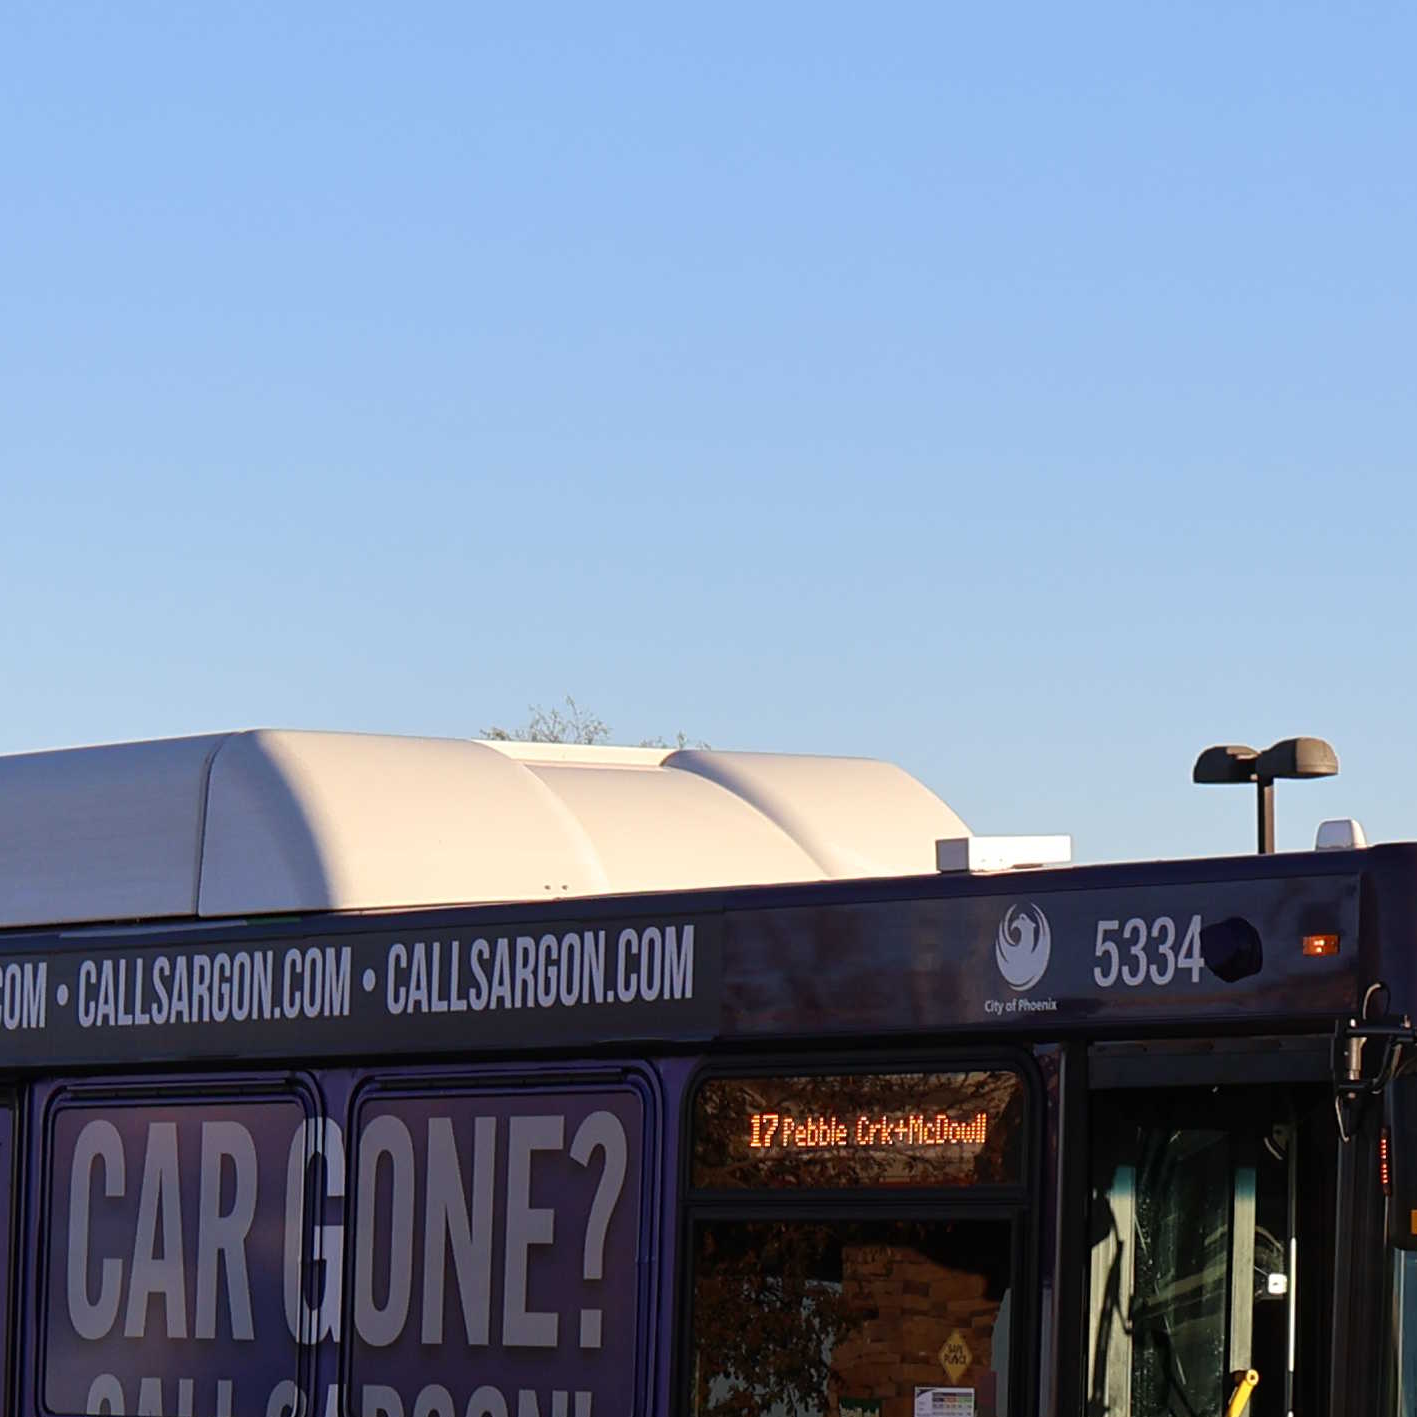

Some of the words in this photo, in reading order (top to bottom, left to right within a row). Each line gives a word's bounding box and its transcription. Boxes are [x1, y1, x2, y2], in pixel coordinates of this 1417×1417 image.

[77, 946, 352, 1028] CALLSARGON.COM
[386, 924, 695, 1015] CALLSARGON.COM
[1093, 913, 1205, 987] 5334
[984, 999, 1004, 1015] City
[1006, 998, 1017, 1011] of
[1019, 998, 1057, 1011] Phoenix
[750, 1113, 779, 1147] 17
[782, 1115, 848, 1147] Pebble
[67, 1118, 258, 1341] CAR
[284, 1111, 628, 1349] GONE?
